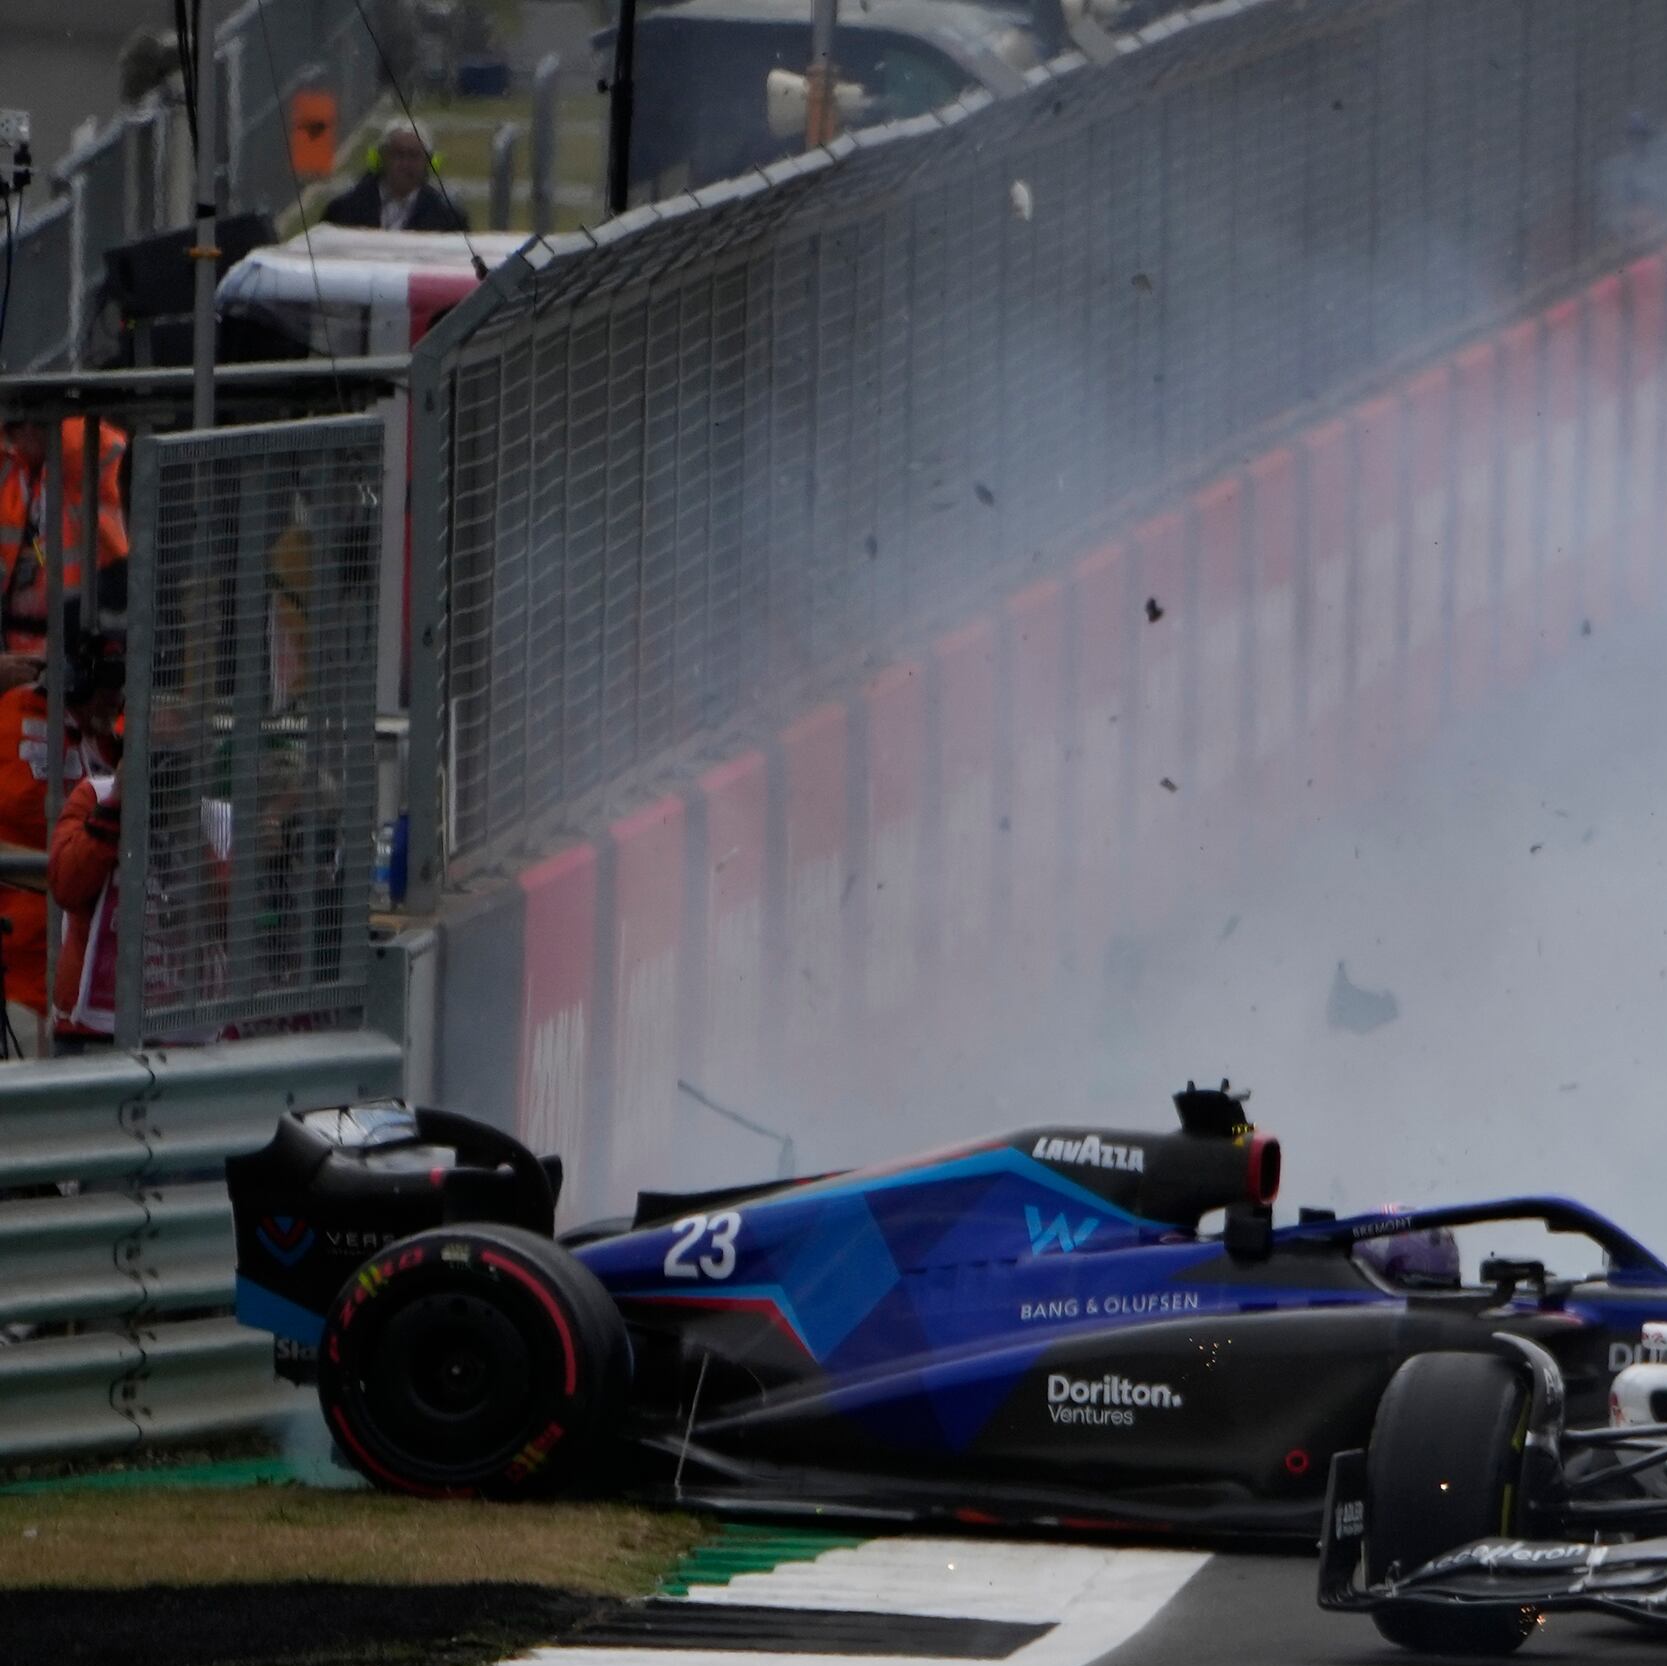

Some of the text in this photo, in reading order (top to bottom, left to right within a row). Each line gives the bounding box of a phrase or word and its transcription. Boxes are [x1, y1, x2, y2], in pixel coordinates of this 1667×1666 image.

[1032, 1135, 1144, 1173] LAVAZZA
[664, 1212, 739, 1279] 23
[1021, 1292, 1199, 1320] BANG & OLUFSEN
[1048, 1404, 1135, 1426] Ventures
